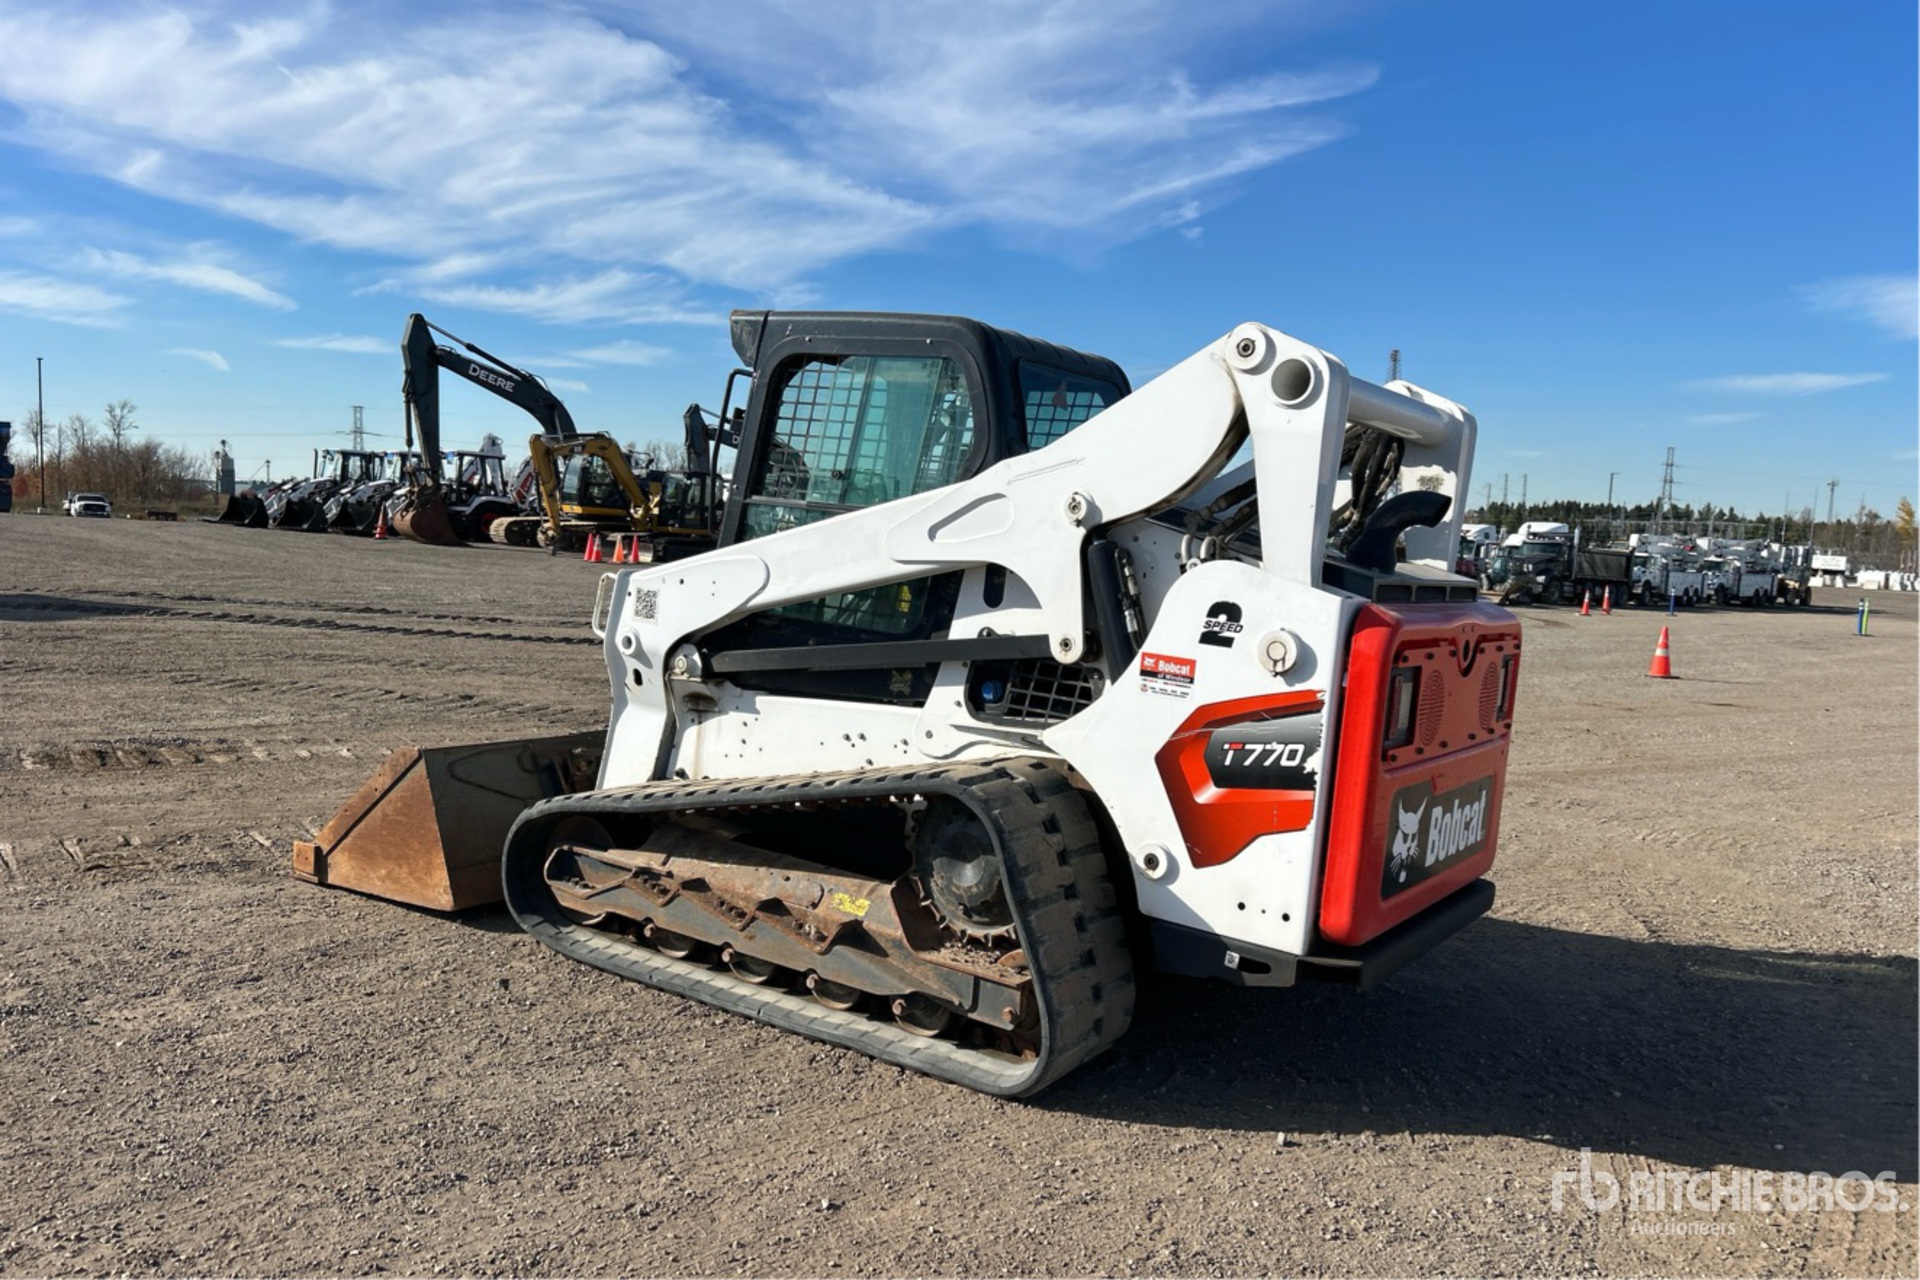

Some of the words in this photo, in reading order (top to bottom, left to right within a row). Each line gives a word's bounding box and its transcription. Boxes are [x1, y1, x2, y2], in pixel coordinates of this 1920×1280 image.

[468, 363, 515, 392] DEERE
[1198, 600, 1243, 649] 2
[1203, 619, 1244, 634] SPEED
[1158, 660, 1191, 675] Bobcat
[1222, 742, 1306, 767] T770
[1424, 789, 1487, 868] Bobcat
